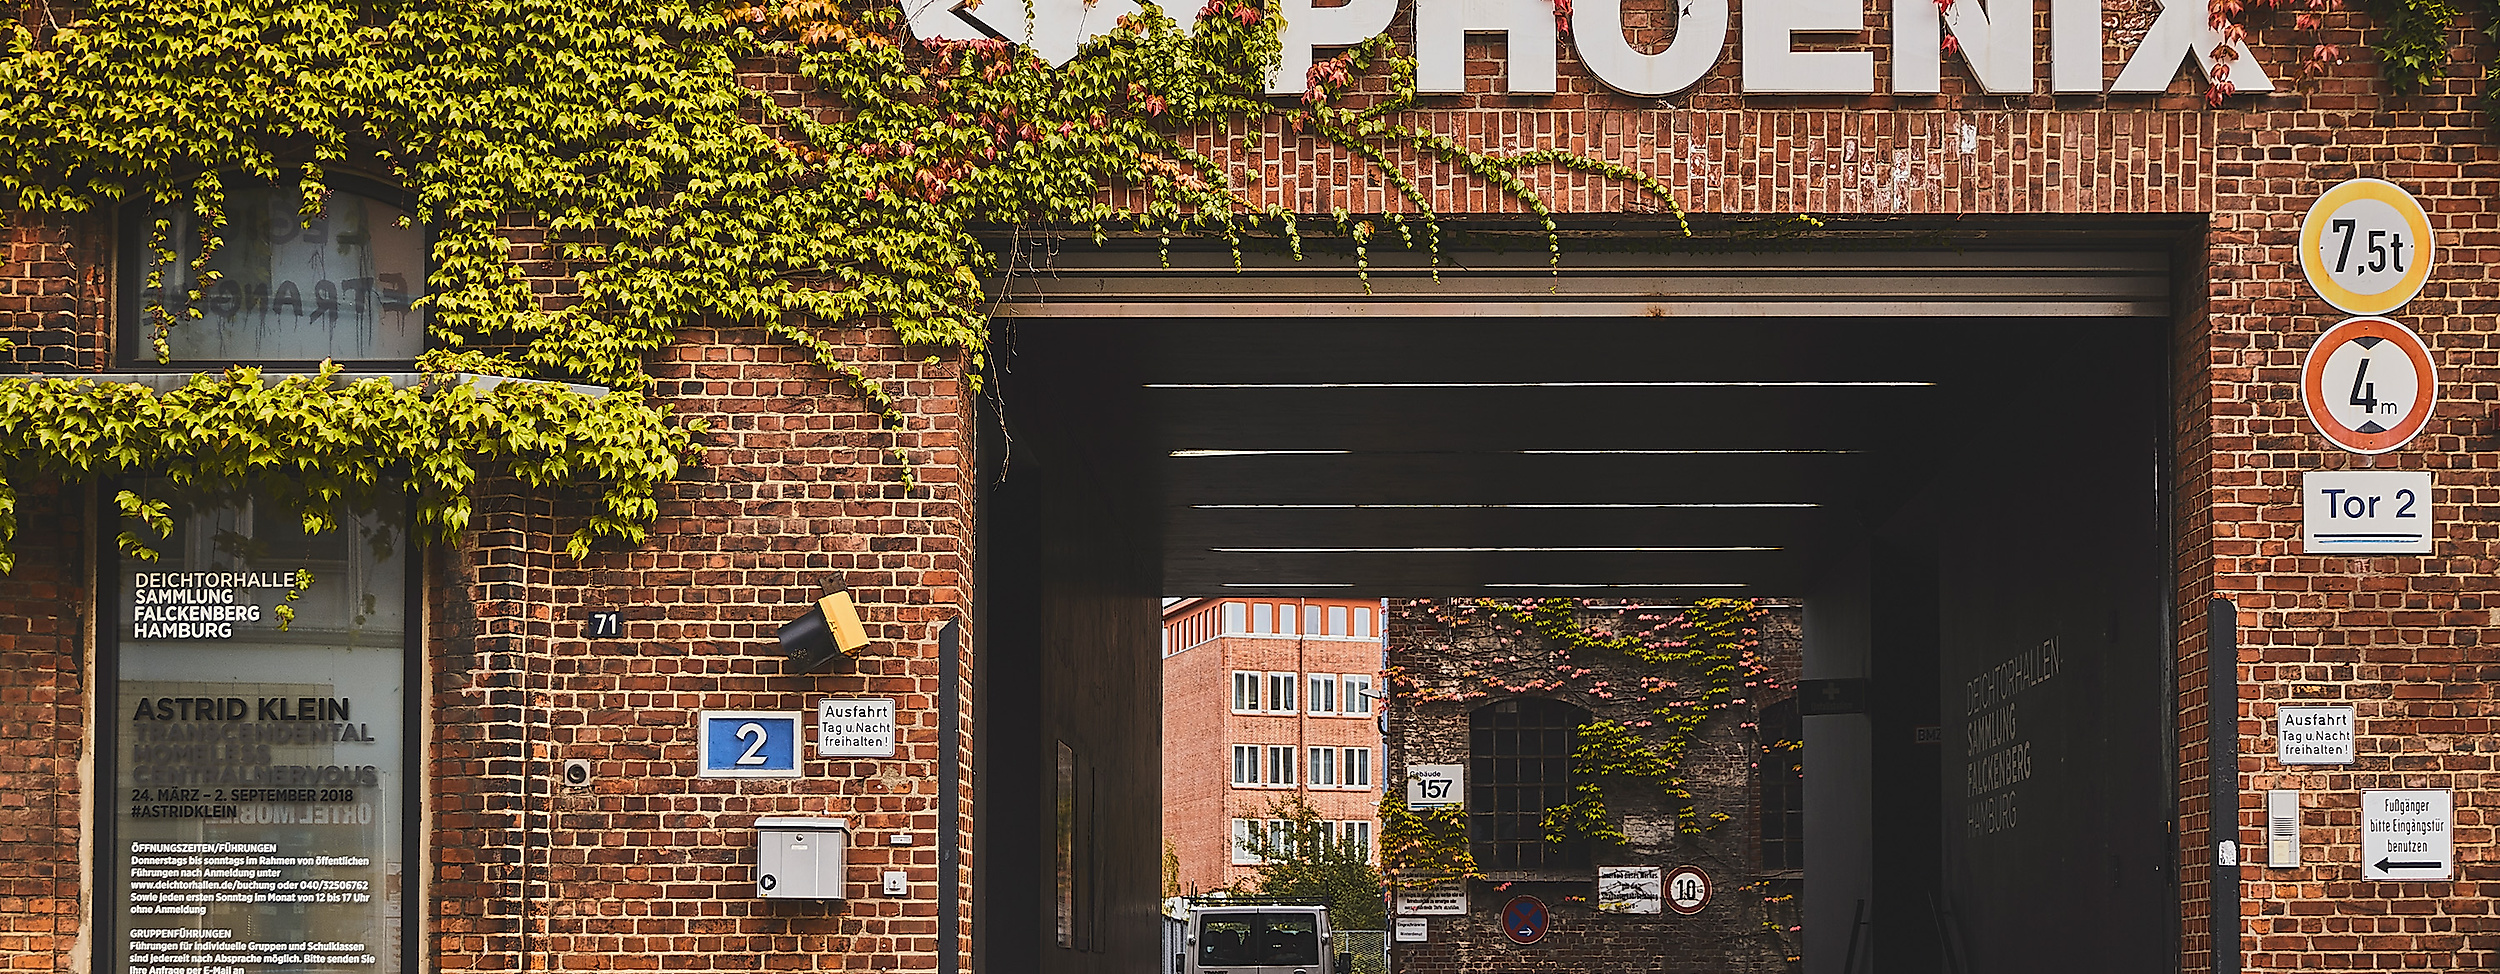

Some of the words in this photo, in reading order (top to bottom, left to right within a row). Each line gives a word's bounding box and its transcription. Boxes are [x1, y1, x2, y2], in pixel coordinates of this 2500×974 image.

[2332, 219, 2404, 276] 7,5t
[2321, 488, 2381, 518] Tor
[2395, 488, 2416, 518] 2
[135, 572, 308, 588] DEICHTORHALLE
[135, 589, 234, 604] SAMMLUNG
[134, 605, 260, 621] FALCKENBERG
[134, 622, 232, 638] HAMBURG
[593, 613, 618, 635] 71
[1966, 635, 2060, 717] DEICHTORHALLEN
[133, 698, 248, 721] ASTRID
[258, 698, 349, 721] KLEIN
[825, 705, 888, 718] Ausfahrt
[2285, 713, 2347, 726] Ausfahrt
[133, 723, 375, 742] TRANSCENDENTAL
[822, 722, 842, 735] Tag
[1967, 702, 2016, 757] SAMMLUNG
[2282, 730, 2302, 743] Tag
[735, 722, 769, 765] 2
[133, 744, 272, 764] HOMELESS
[1967, 740, 2031, 798] FALCKENBERG
[131, 789, 154, 802] 24.
[158, 786, 200, 802] MÄRZ
[214, 789, 228, 802] 2.
[231, 789, 316, 802] SEPTEMBER
[320, 789, 354, 802] 2018
[1417, 779, 1453, 799] 157
[131, 805, 238, 819] #ASTRIDKLEIN
[1967, 790, 2017, 839] HAMBURG
[2385, 798, 2430, 815] Fußgänger
[2370, 819, 2391, 832] bitte
[2387, 839, 2428, 852] benutzen
[131, 856, 187, 866] Donnerstags
[189, 856, 202, 865] bis
[204, 856, 244, 866] sonntags
[246, 856, 257, 865] im
[259, 856, 295, 865] Rahmen
[315, 856, 370, 865] öffentlichen
[131, 868, 179, 878] Führungen
[180, 868, 202, 877] nach
[204, 868, 255, 878] Anmeldung
[257, 869, 281, 877] unter
[277, 880, 299, 889] oder
[300, 880, 369, 890] 040/32506762
[1676, 879, 1696, 901] 10
[130, 893, 158, 901] Sowie
[159, 893, 184, 903] jeden
[215, 893, 253, 903] Sonntag
[254, 893, 266, 901] im
[267, 893, 296, 901] Monat
[315, 893, 325, 902] 12
[327, 893, 341, 902] bis
[342, 893, 351, 902] 17
[353, 893, 371, 902] Uhr
[130, 905, 153, 913] ohne
[154, 905, 207, 915] Anmeldung
[130, 928, 232, 938] GRUPPENFÜHRUNGEN
[129, 942, 178, 952] Führungen
[179, 942, 193, 950] für
[194, 942, 247, 950] individuelle
[248, 942, 287, 952] Gruppen
[288, 942, 306, 951] und
[307, 942, 365, 951] Schulklassen
[129, 954, 149, 963] sind
[150, 954, 190, 964] jederzeit
[191, 954, 213, 963] nach
[214, 954, 262, 964] Absprache
[263, 954, 302, 964] möglich.
[303, 954, 325, 963] Bitte
[327, 954, 360, 963] senden
[361, 954, 376, 963] Sie
[129, 966, 147, 974] Ihre
[148, 966, 185, 974] Anfrage
[204, 966, 231, 974] E-Mail
